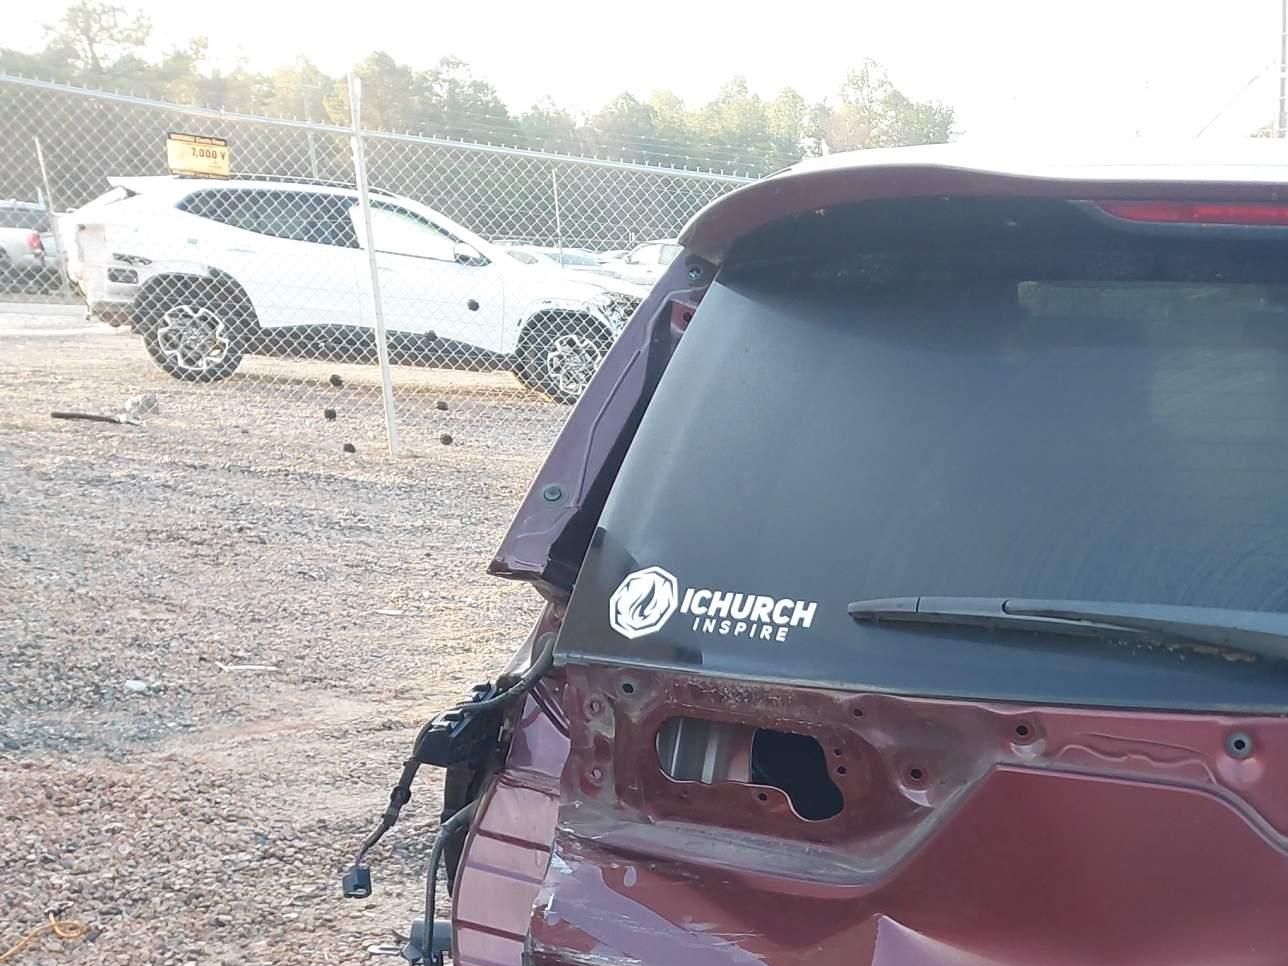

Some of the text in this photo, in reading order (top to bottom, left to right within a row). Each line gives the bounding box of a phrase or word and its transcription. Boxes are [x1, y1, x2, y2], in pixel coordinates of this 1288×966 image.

[191, 147, 217, 159] 7,000
[680, 588, 818, 628] ICHURCH
[692, 617, 789, 642] INSPIRE
